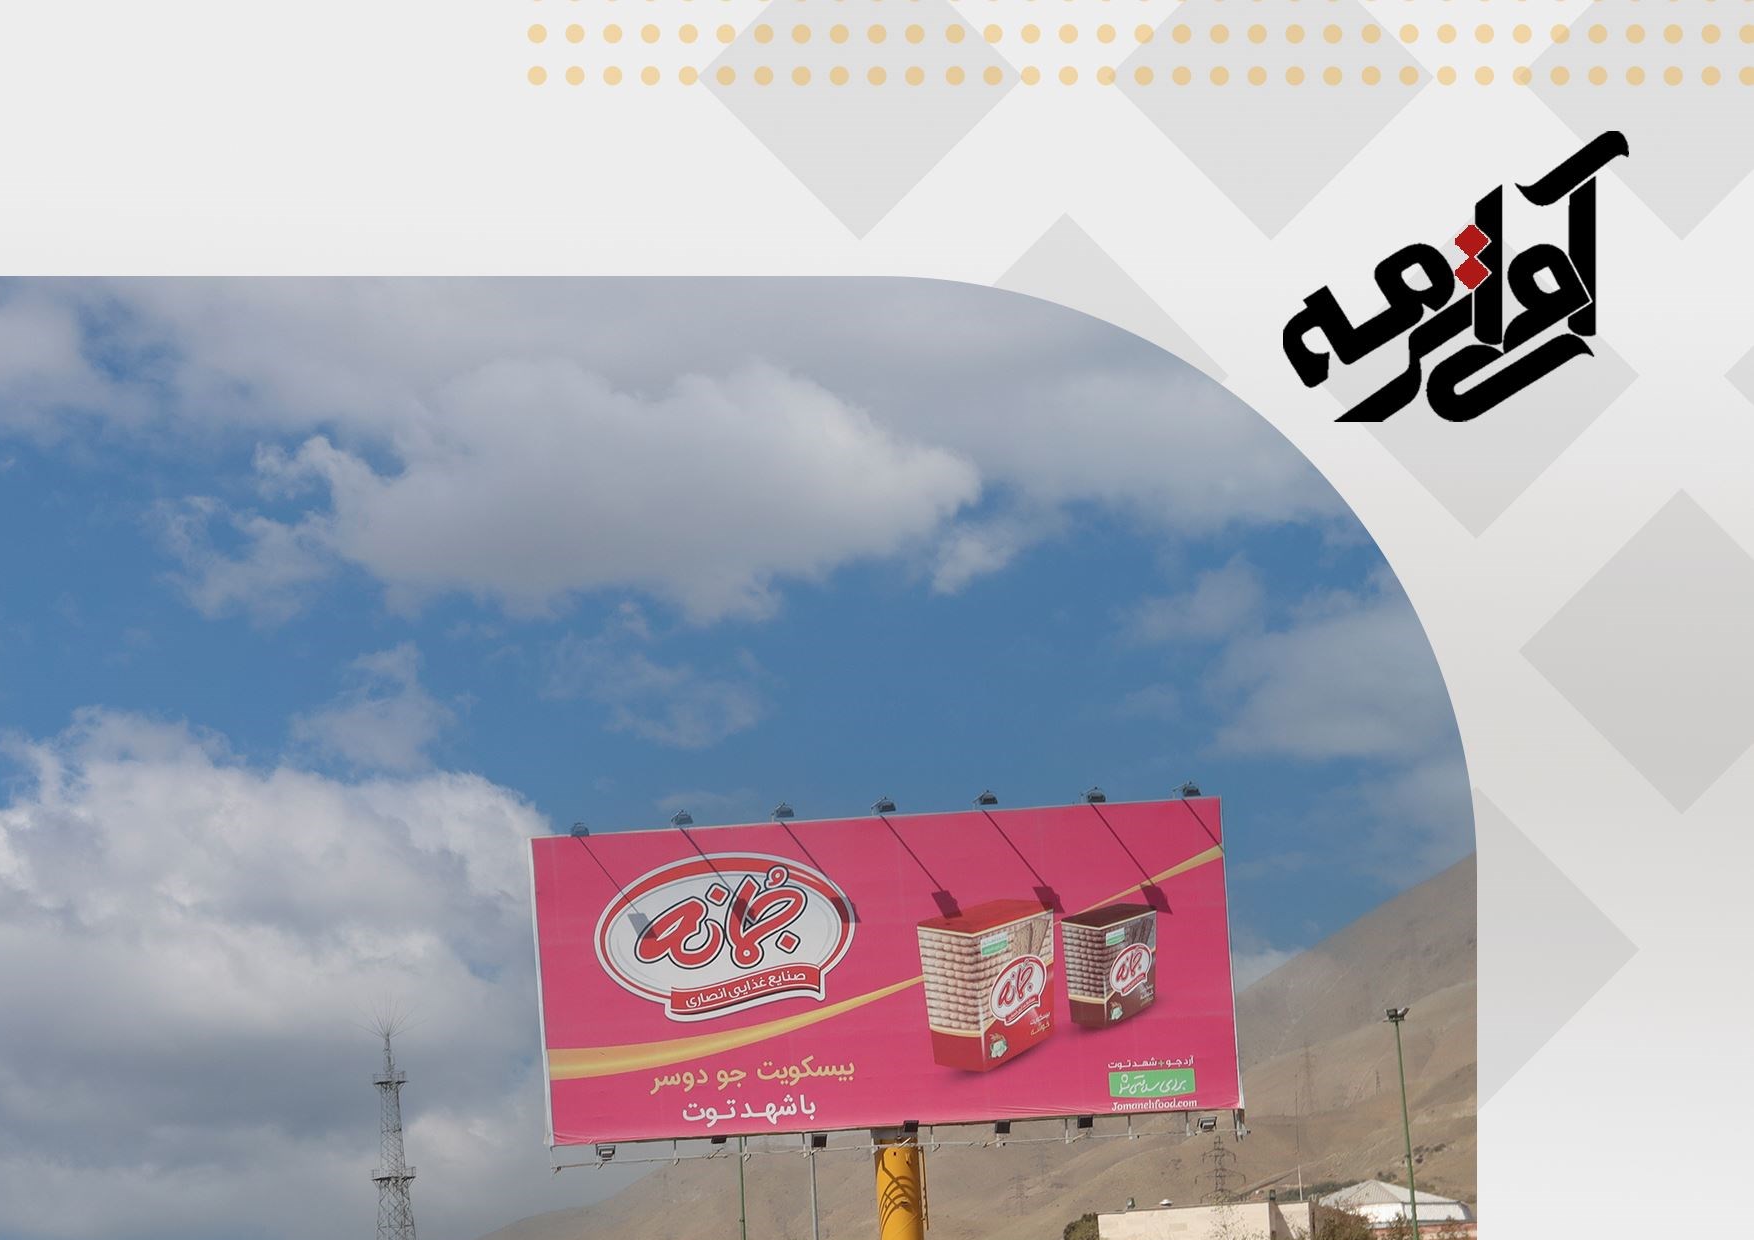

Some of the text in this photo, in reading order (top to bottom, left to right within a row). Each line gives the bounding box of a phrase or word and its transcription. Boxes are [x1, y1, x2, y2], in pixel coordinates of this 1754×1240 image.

[685, 970, 807, 1009] صنایع غذایی انصاری
[650, 1055, 855, 1095] بیسکویت جو دوسر
[1108, 1059, 1131, 1070] توت
[682, 1093, 817, 1128] با شهد توت
[1111, 1097, 1198, 1112] Jomanehfood.com
